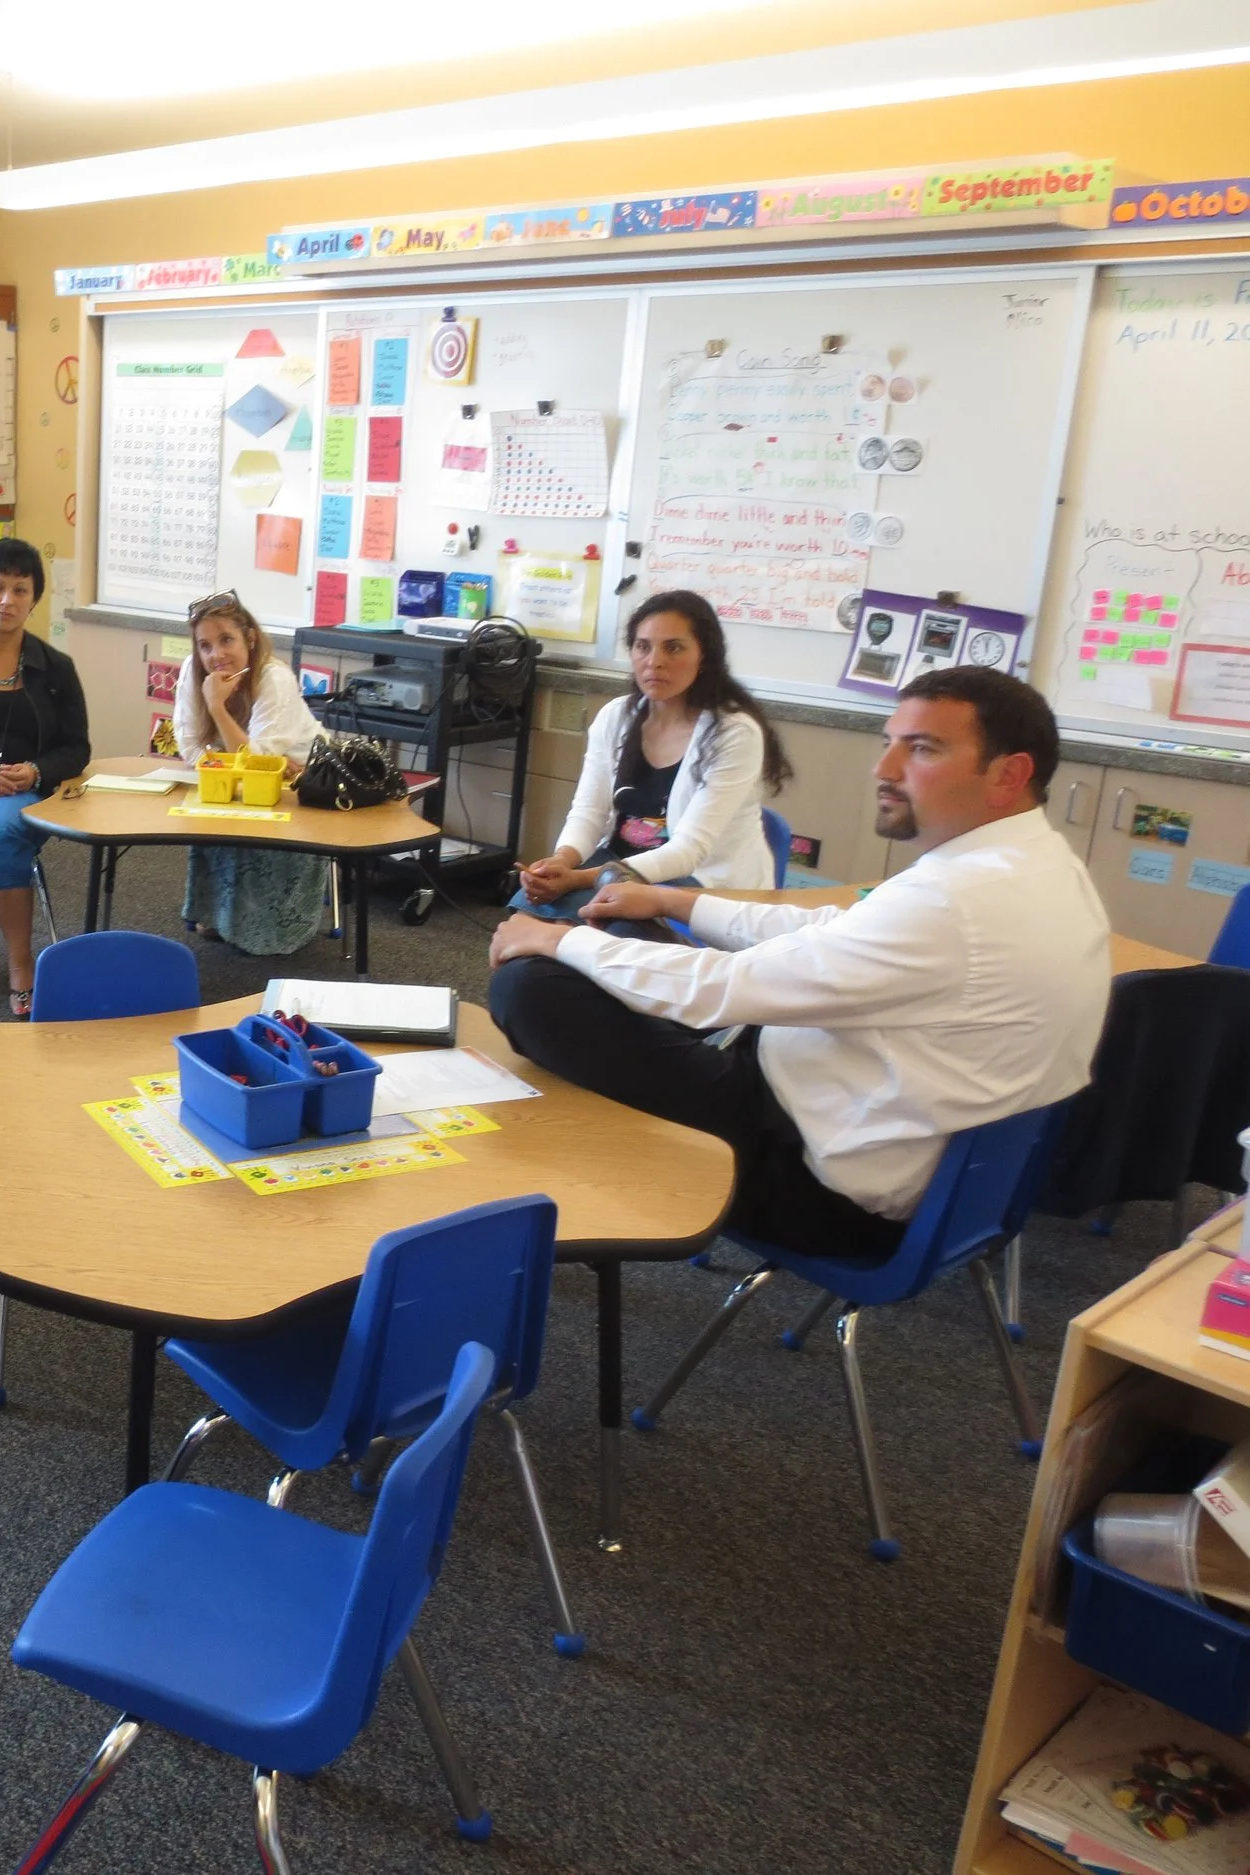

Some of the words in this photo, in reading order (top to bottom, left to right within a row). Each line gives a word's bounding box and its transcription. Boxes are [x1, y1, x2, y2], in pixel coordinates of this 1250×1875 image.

[937, 169, 1095, 207] September
[658, 200, 708, 230] July
[788, 189, 888, 221] August
[1141, 185, 1250, 221] Octob
[405, 228, 445, 251] May
[521, 218, 571, 239] June
[296, 232, 340, 258] April
[69, 273, 123, 291] January
[1116, 288, 1180, 314] Today
[1193, 294, 1215, 310] is
[1116, 318, 1178, 354] April
[153, 365, 184, 374] Number
[186, 364, 204, 374] Grid
[736, 348, 770, 369] Coin
[780, 346, 823, 375] Song
[716, 384, 759, 400] penny
[779, 470, 818, 488] know
[653, 501, 689, 521] Dime
[694, 503, 731, 523] dime
[737, 504, 776, 525] little
[782, 508, 808, 526] and
[814, 508, 847, 527] thin
[659, 529, 725, 549] remember
[731, 533, 772, 554] you're
[775, 538, 823, 553] worth
[1083, 517, 1123, 539] Who
[1130, 525, 1147, 541] is
[1153, 523, 1181, 543] at
[648, 554, 701, 573] Quarter
[706, 559, 758, 579] quarter
[766, 560, 788, 585] big
[793, 564, 821, 583] and
